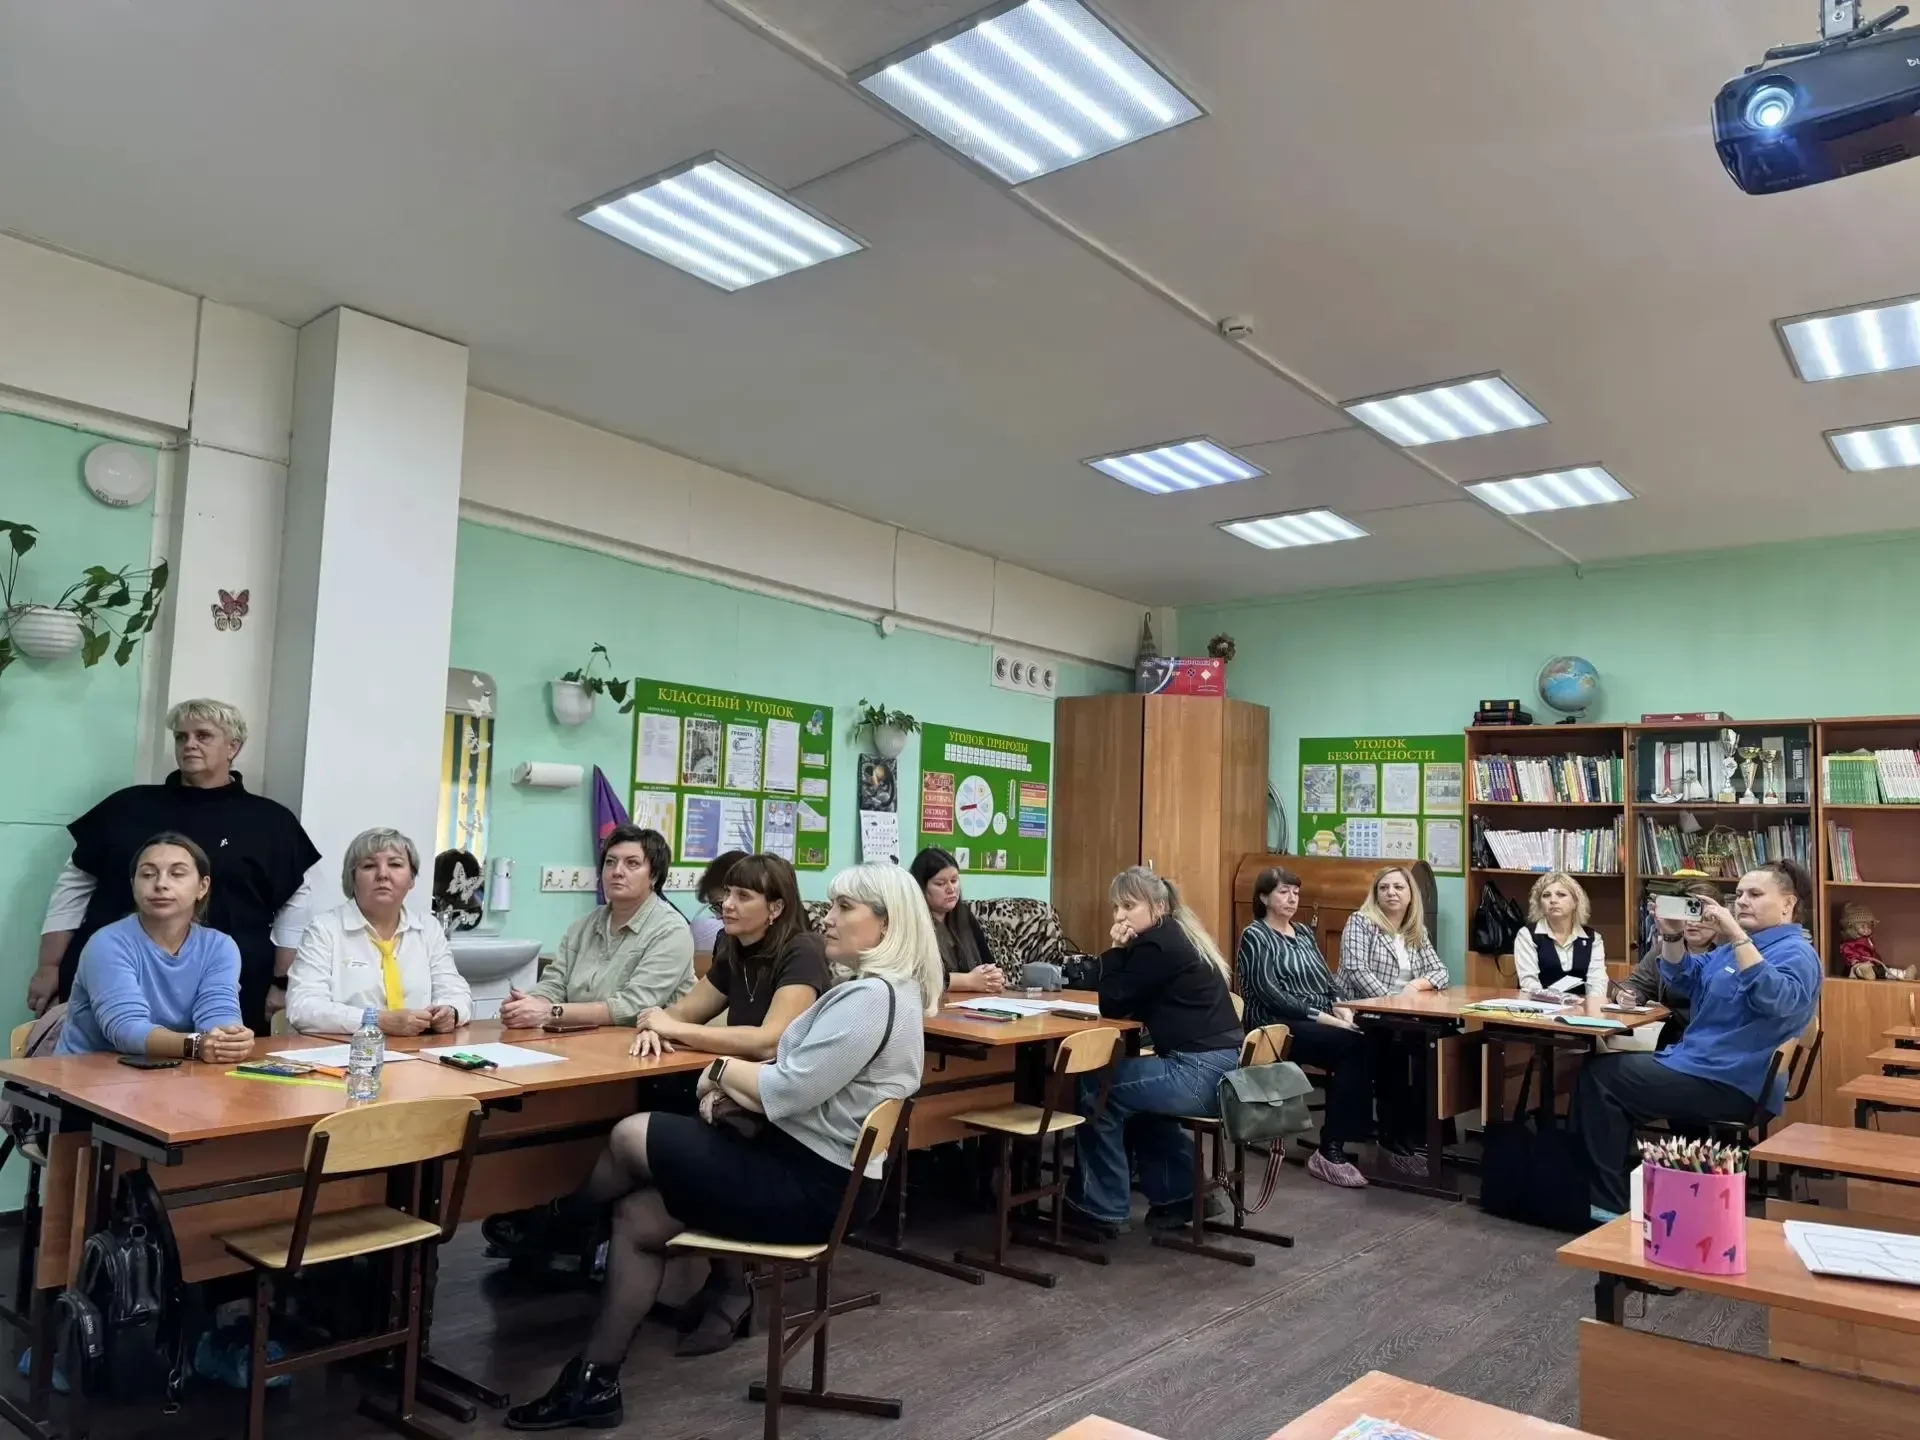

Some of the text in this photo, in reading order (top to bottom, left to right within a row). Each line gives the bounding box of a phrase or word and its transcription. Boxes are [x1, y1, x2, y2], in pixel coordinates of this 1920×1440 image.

[658, 687, 794, 718] КЛАССНЫЙ УГОЛОК
[949, 731, 1028, 753] УГОЛОК ПРИРОДЫ
[1354, 739, 1407, 749] УГОЛОК
[1327, 750, 1436, 761] БЕЗОПАСНОСТИ
